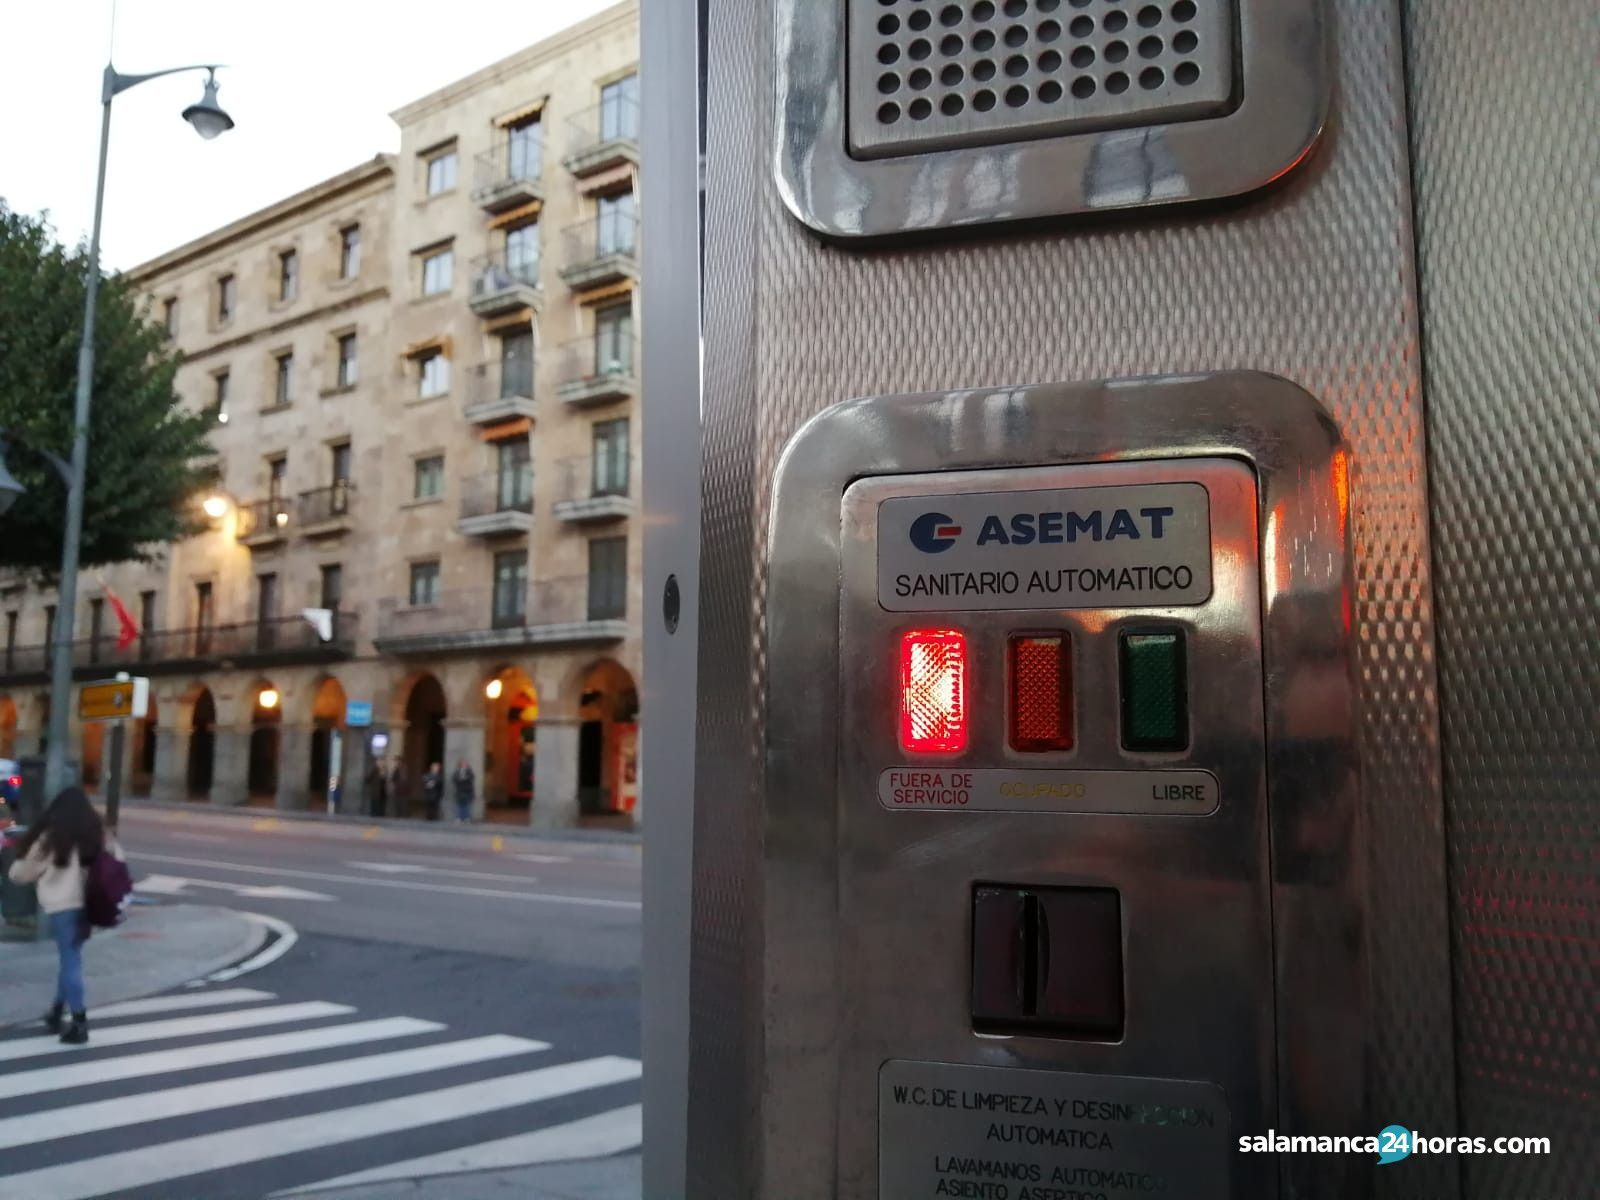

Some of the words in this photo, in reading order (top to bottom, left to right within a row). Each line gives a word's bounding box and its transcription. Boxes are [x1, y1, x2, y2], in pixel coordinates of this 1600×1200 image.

[976, 506, 1174, 546] ASEMAT
[895, 571, 1019, 597] SANITARIO
[1026, 565, 1193, 594] AUTOMATICO
[890, 772, 942, 789] FUERA
[951, 773, 974, 789] DE
[999, 782, 1087, 799] OCUPADO
[1152, 784, 1206, 801] LIBRE
[893, 789, 969, 805] SERVICIO
[962, 1091, 1048, 1116] LIMPIEZA
[1053, 1098, 1067, 1117] Y
[986, 1123, 1113, 1150] AUTOMATICA
[935, 1155, 1041, 1182] LAVAMANOS
[936, 1178, 1009, 1200] ASIENTO
